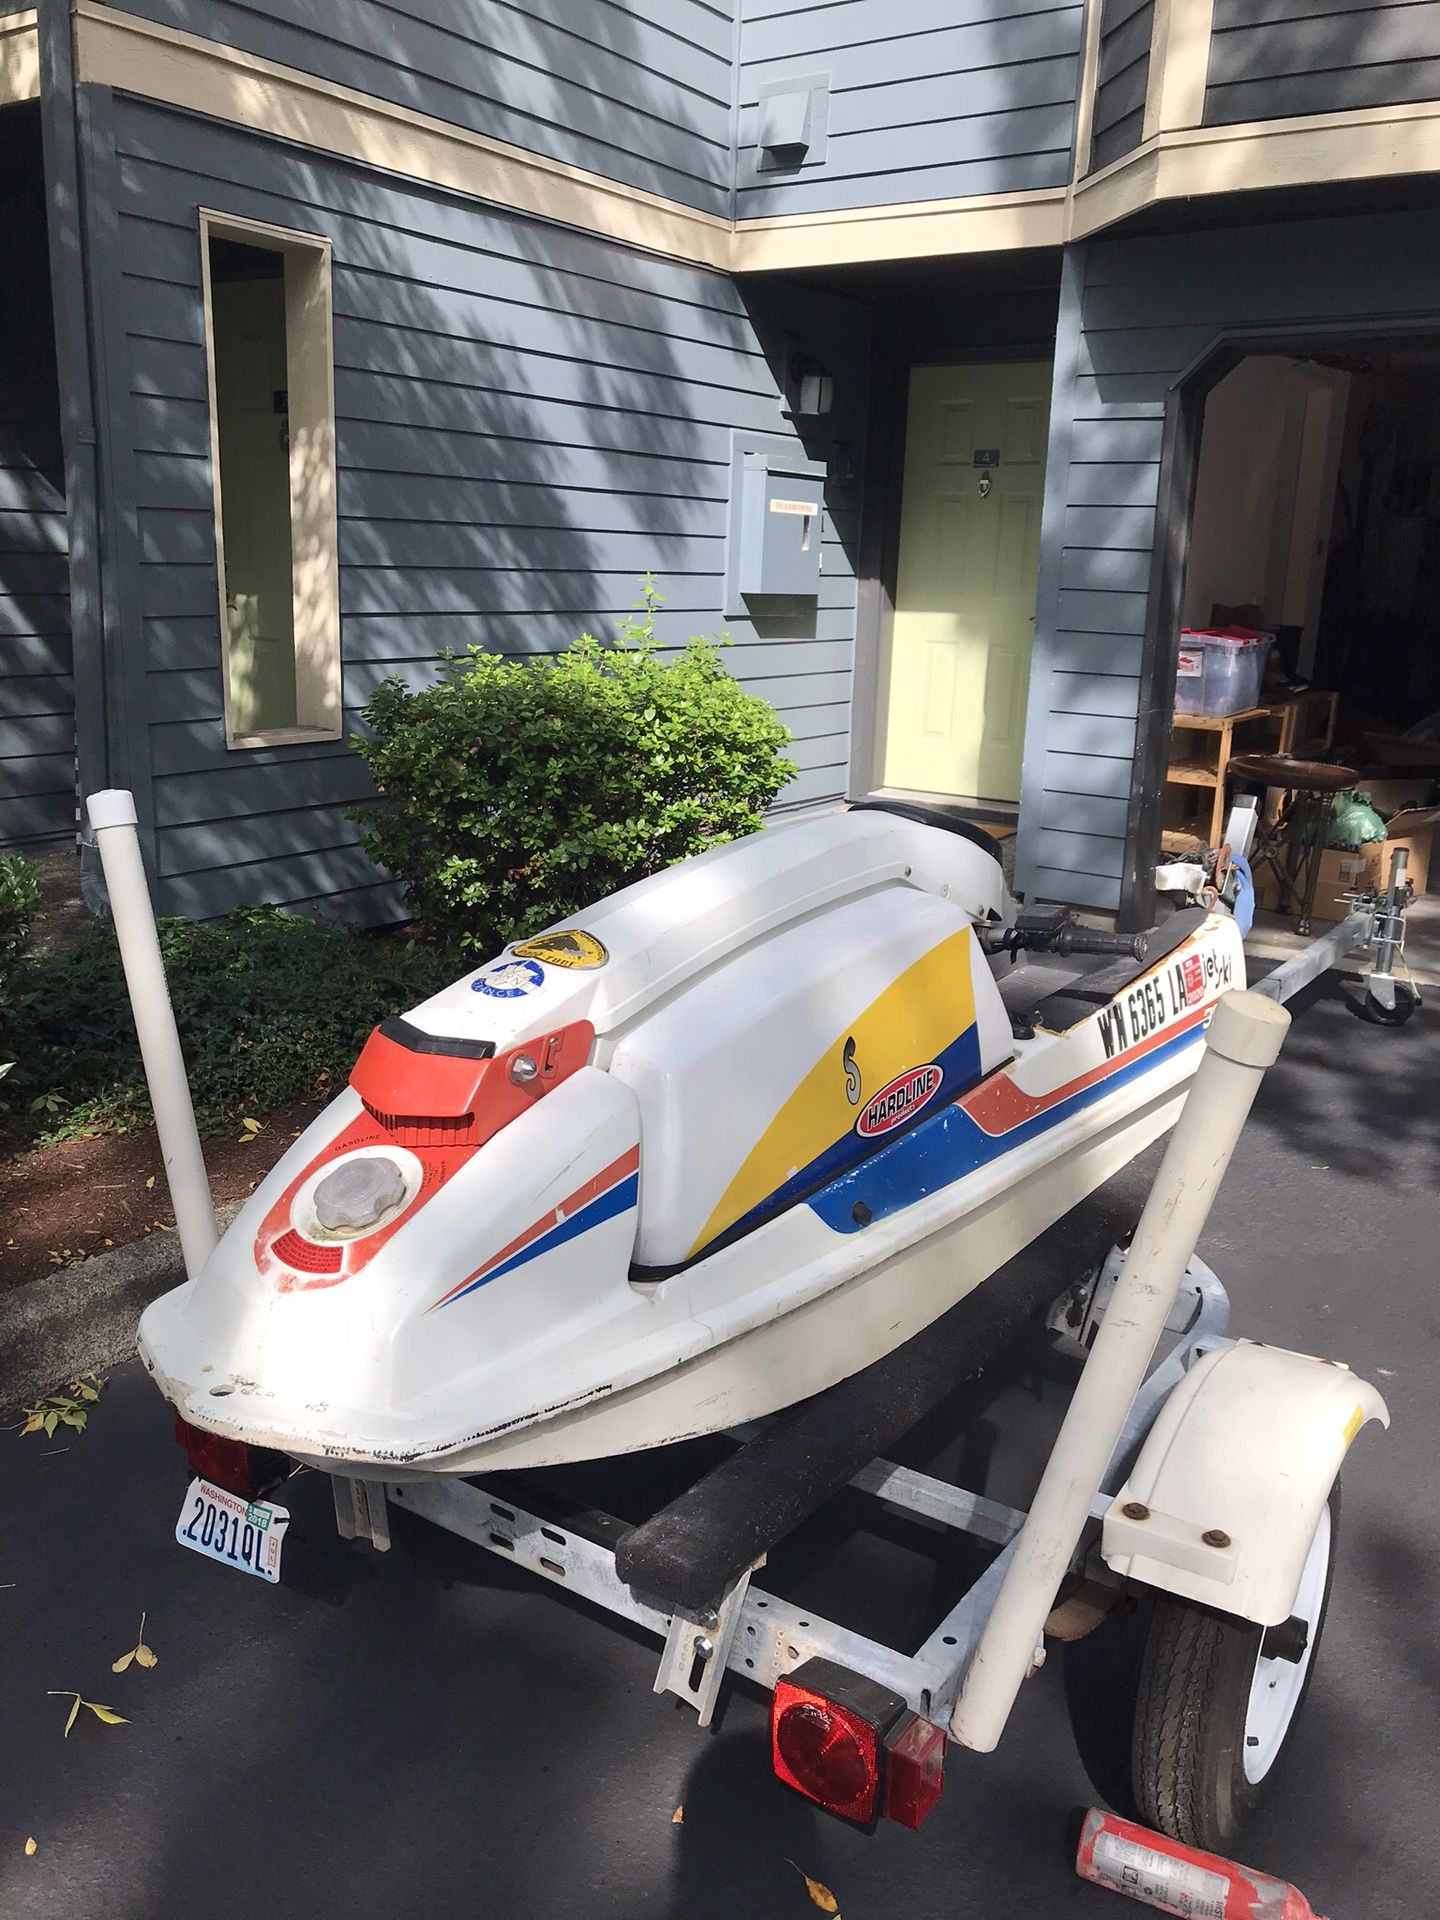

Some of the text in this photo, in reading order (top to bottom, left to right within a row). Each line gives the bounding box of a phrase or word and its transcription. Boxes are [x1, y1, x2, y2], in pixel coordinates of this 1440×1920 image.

[1097, 1001, 1128, 1059] WN
[1128, 976, 1166, 1043] 6365
[1168, 964, 1189, 1016] LA
[866, 1067, 935, 1131] HARDLINE
[334, 1134, 381, 1151] GASOLINE
[200, 1483, 247, 1516] WASHINGTON
[247, 1513, 268, 1529] 2018
[186, 1496, 266, 1574] 2031QL
